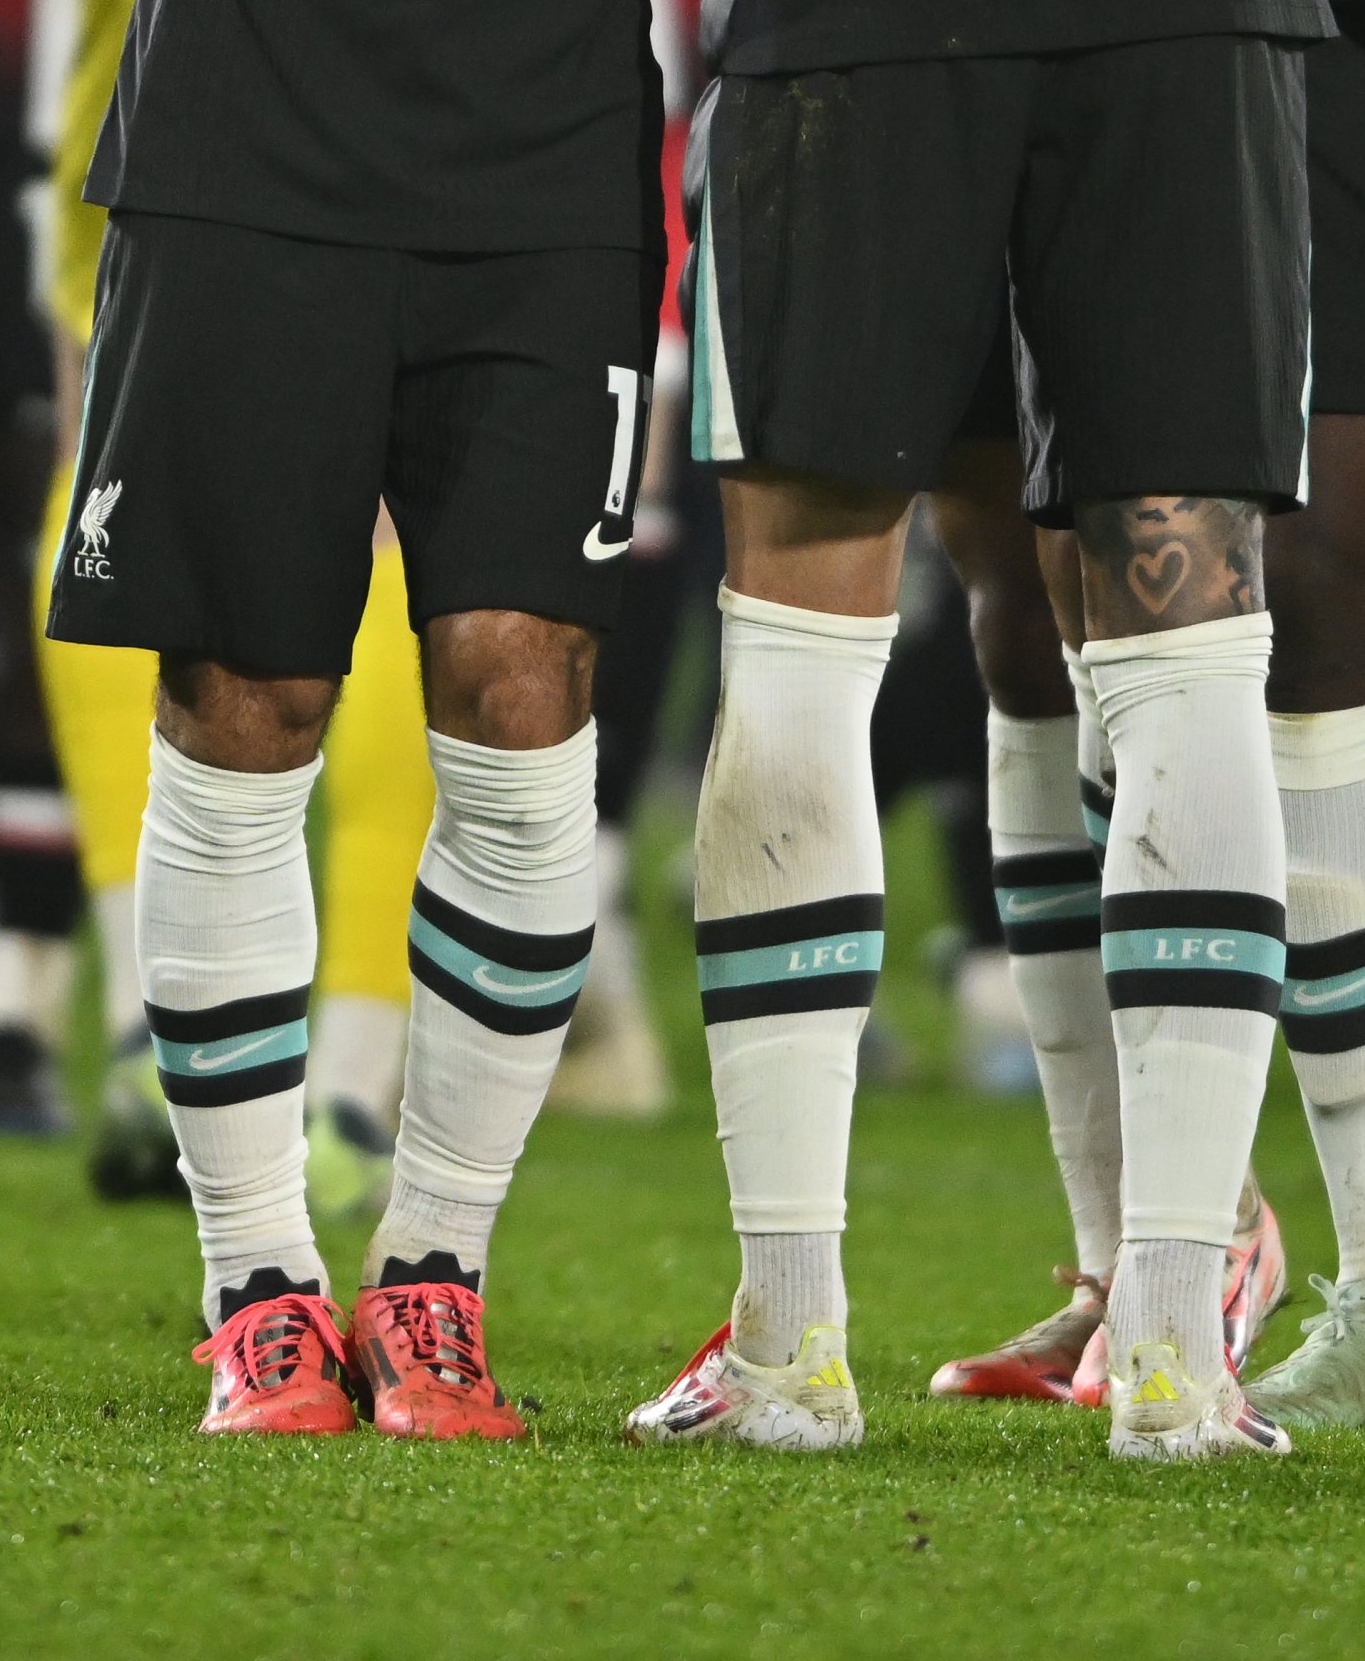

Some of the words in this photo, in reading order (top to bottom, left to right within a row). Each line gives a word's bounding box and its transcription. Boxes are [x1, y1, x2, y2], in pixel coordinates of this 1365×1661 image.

[73, 556, 115, 580] L.F.C.
[786, 942, 860, 972] LFC
[1152, 937, 1236, 961] LFC
